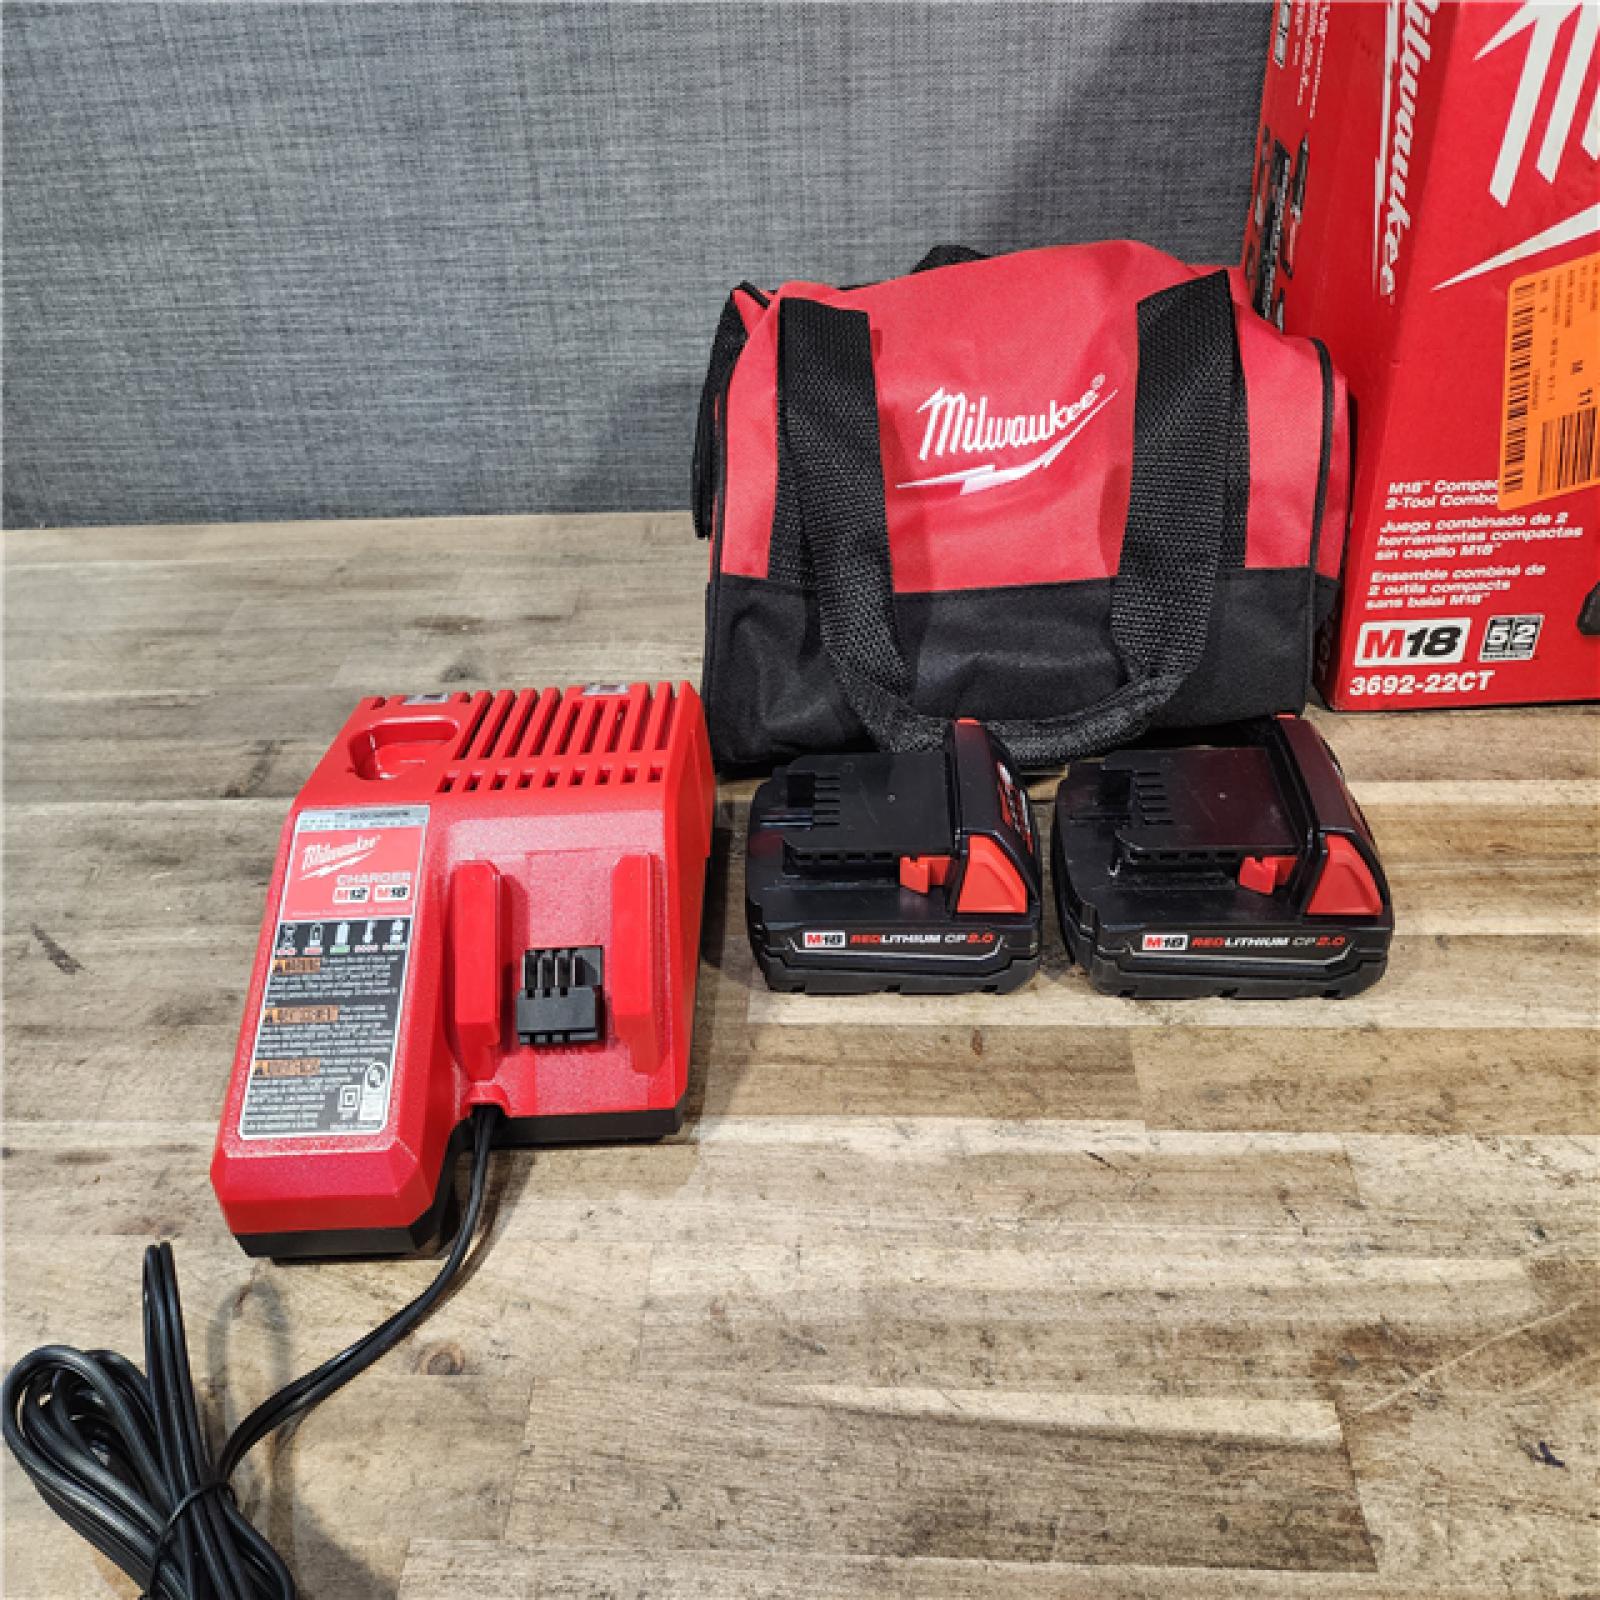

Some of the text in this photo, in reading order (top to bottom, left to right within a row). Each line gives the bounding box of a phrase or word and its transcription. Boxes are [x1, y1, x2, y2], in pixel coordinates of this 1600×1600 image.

[1380, 0, 1440, 305] ilwaukee
[1380, 511, 1568, 533] Juego combinado de 2
[1377, 526, 1584, 546] herramientas compactas
[1375, 548, 1399, 561] sin
[1402, 546, 1456, 560] cepillo
[1371, 569, 1449, 582] Ensemble
[1525, 563, 1546, 576] de
[1383, 581, 1427, 596] outils
[1364, 598, 1403, 610] sans
[1407, 595, 1446, 609] balai
[1362, 626, 1463, 659] M18
[1349, 669, 1495, 696] 3692-22CT
[850, 933, 941, 945] REDLITHIUM
[1191, 936, 1290, 947] REDLITHIUM
